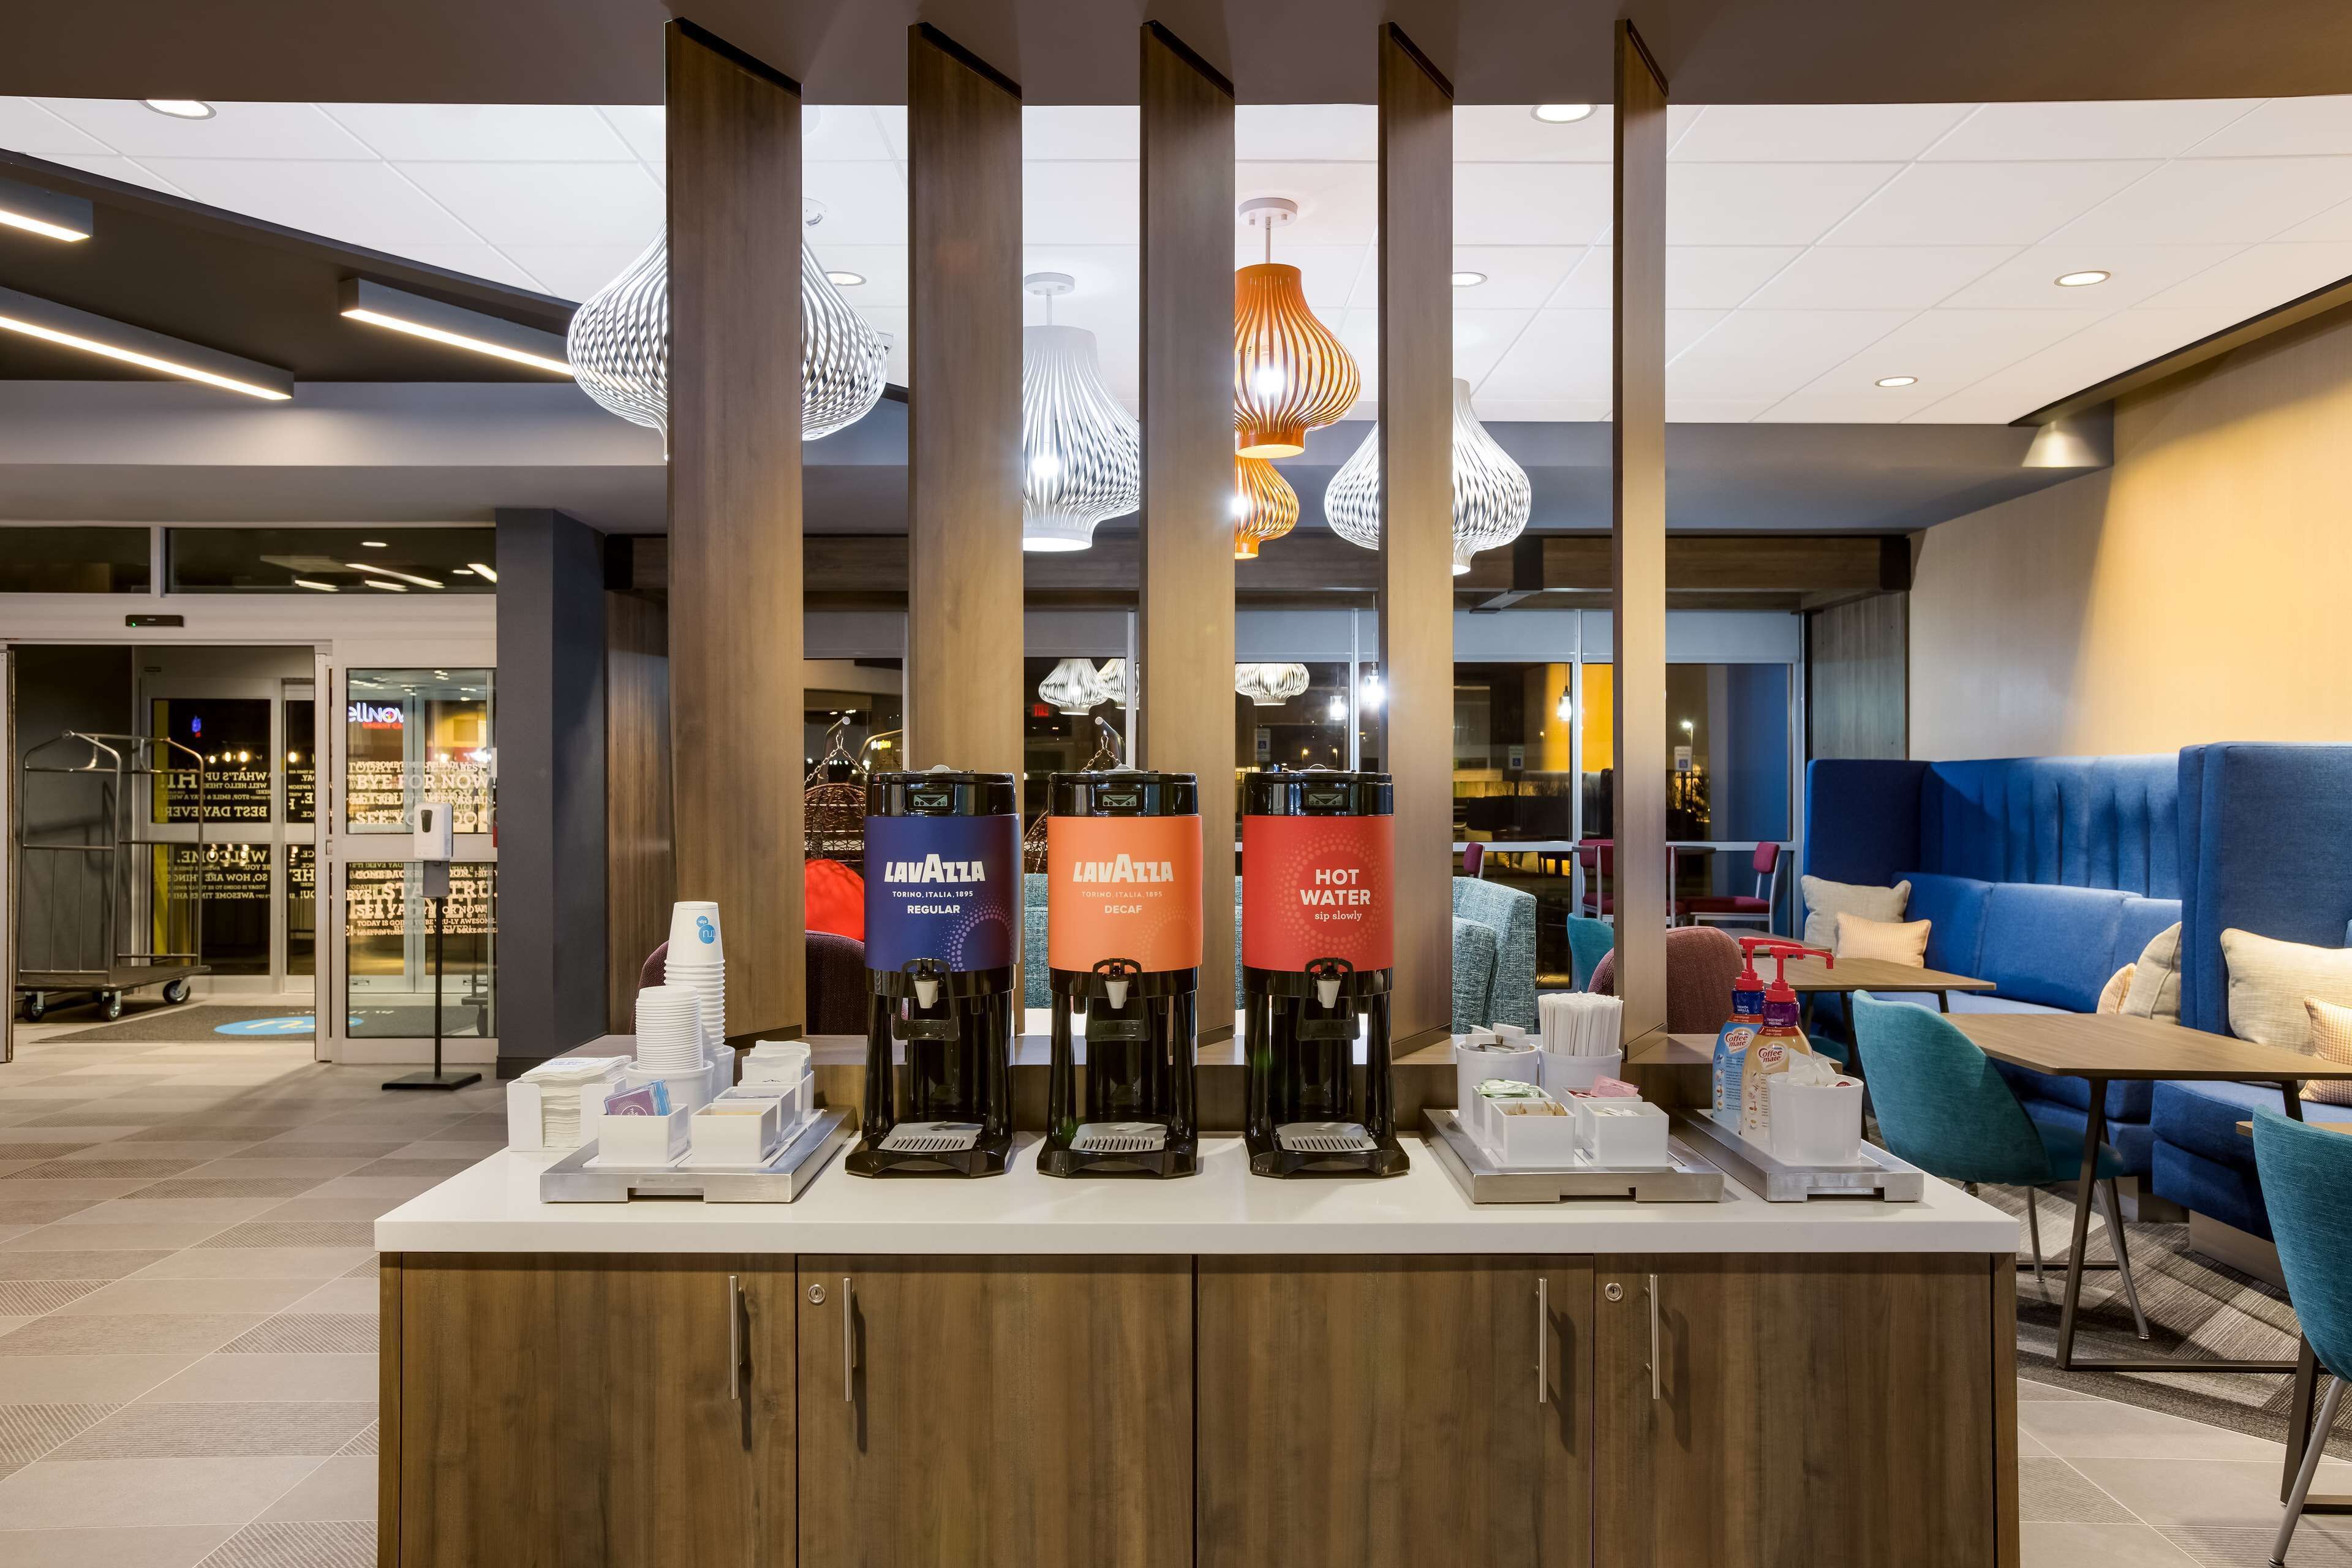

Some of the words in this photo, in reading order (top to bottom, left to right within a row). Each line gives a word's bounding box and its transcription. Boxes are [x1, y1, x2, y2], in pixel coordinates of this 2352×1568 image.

[355, 774, 393, 790] BYE
[398, 774, 435, 789] FOR
[884, 853, 986, 883] LAVAZZA
[1072, 853, 1174, 883] LAVAZZA
[1315, 869, 1359, 884] HOT
[1300, 889, 1371, 905] WATER
[907, 905, 960, 914] REGULAR
[1104, 905, 1142, 913] DECAF
[1314, 911, 1330, 922] sip
[1332, 910, 1362, 921] slowly
[1725, 1033, 1748, 1043] Coffee
[1758, 1048, 1782, 1058] Coffee
